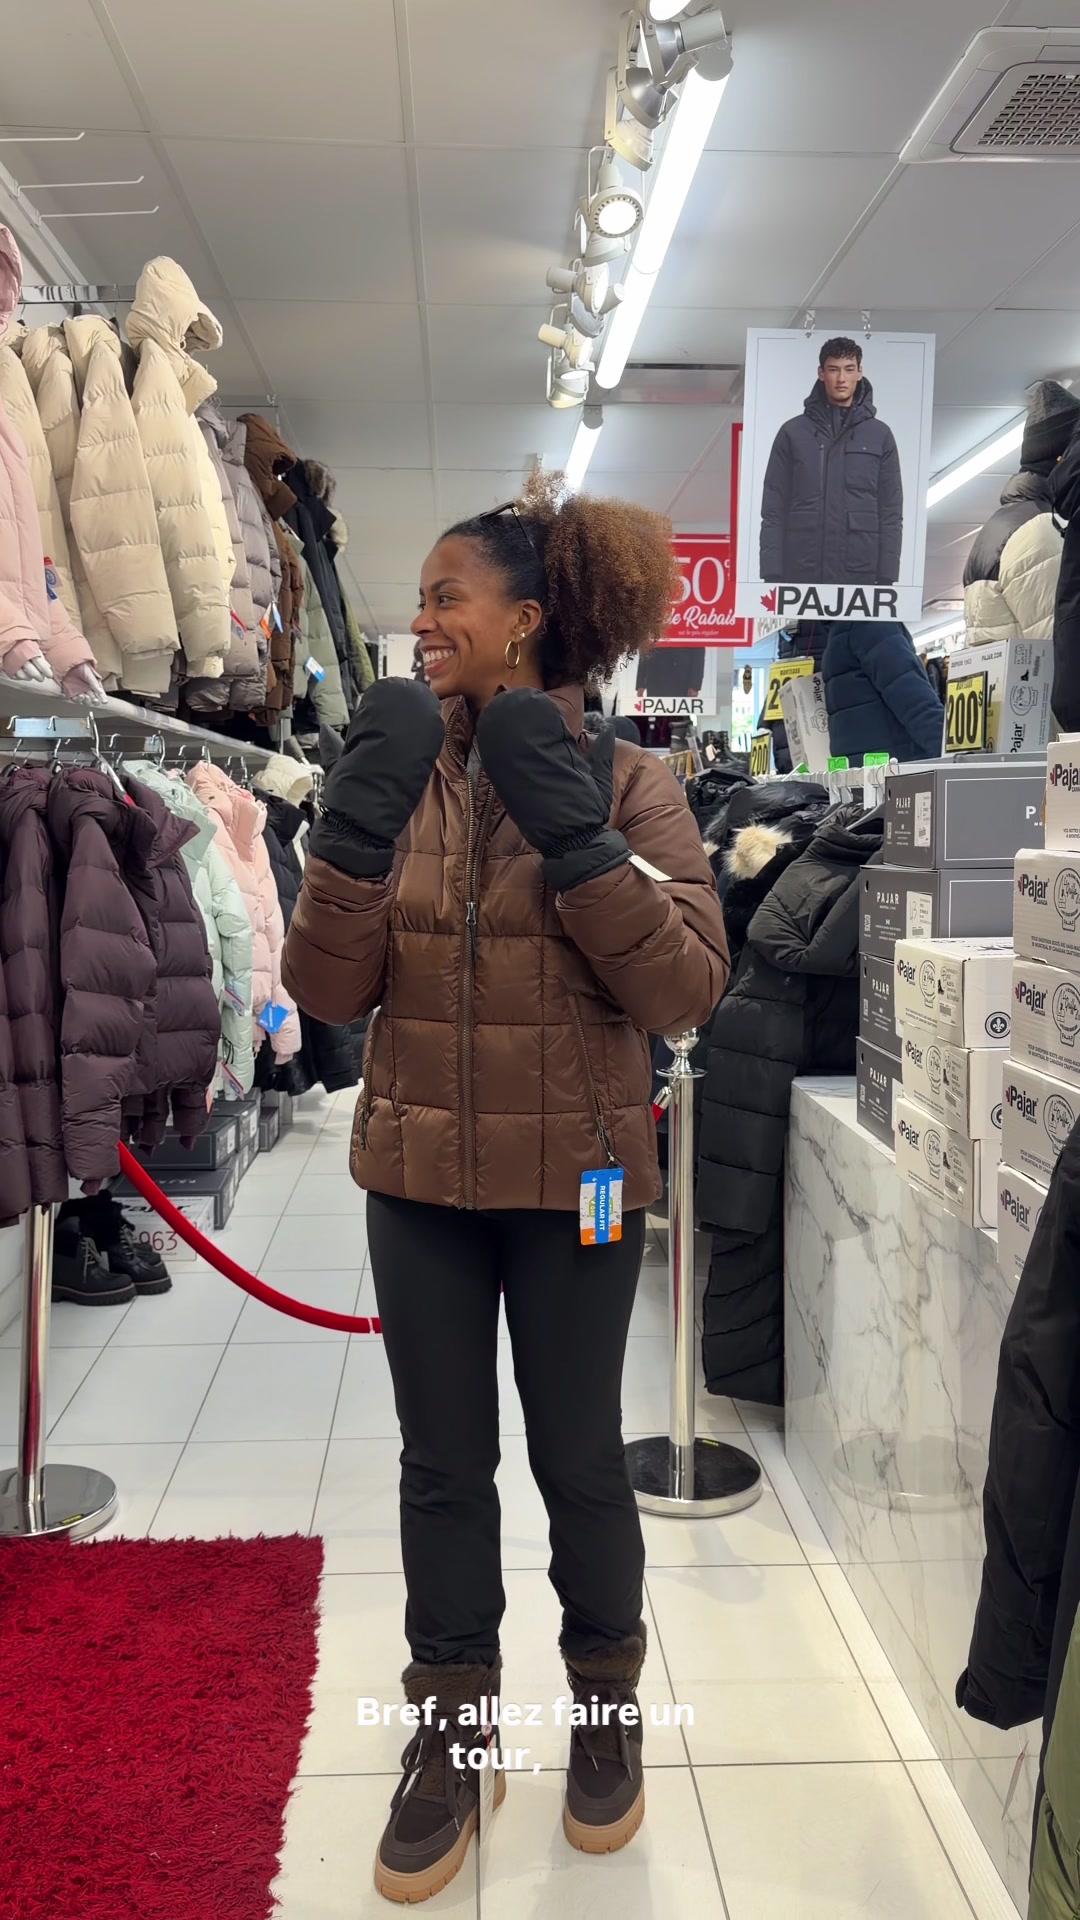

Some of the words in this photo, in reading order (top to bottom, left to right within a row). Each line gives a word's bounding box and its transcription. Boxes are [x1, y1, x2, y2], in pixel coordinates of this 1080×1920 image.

[777, 586, 898, 618] PAJAR
[683, 605, 736, 630] Rabais
[642, 698, 703, 714] PAJAR
[1054, 763, 1080, 791] Paja
[896, 797, 910, 808] PAJAR
[876, 891, 899, 904] PAJAR
[1022, 873, 1048, 902] Pajar
[900, 959, 915, 982] Pajar
[872, 979, 889, 995] PAJAR
[1019, 981, 1047, 1011] Pajar
[907, 1041, 923, 1064] Pajar
[869, 1067, 887, 1087] PAJAR
[1010, 1085, 1038, 1117] Pajar
[901, 1119, 919, 1145] Pajar
[1005, 1189, 1030, 1223] Pajar
